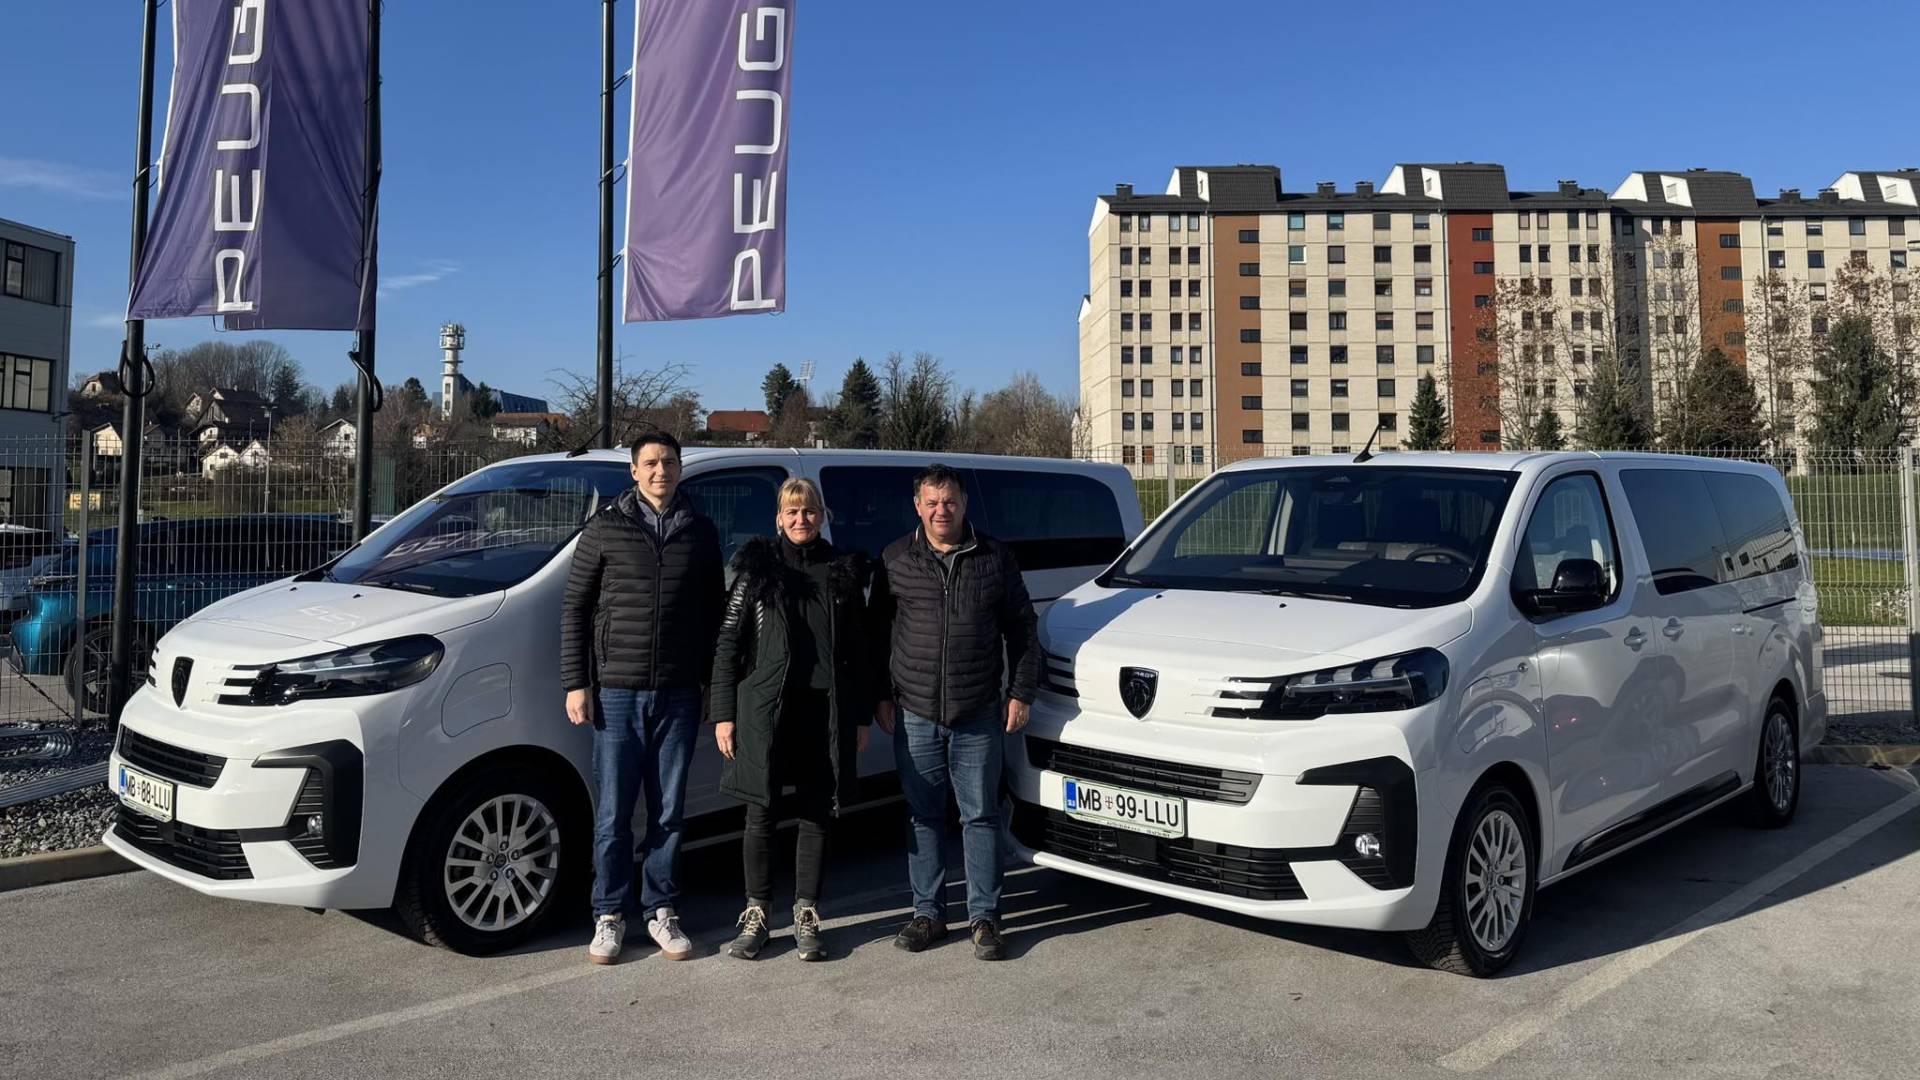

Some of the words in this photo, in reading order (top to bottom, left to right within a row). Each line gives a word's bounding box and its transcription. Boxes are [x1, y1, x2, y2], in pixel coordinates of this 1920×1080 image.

[730, 7, 785, 311] PEUG
[141, 780, 171, 811] 88-LLU
[1077, 786, 1102, 811] MB
[1116, 794, 1179, 827] 99-LLU
